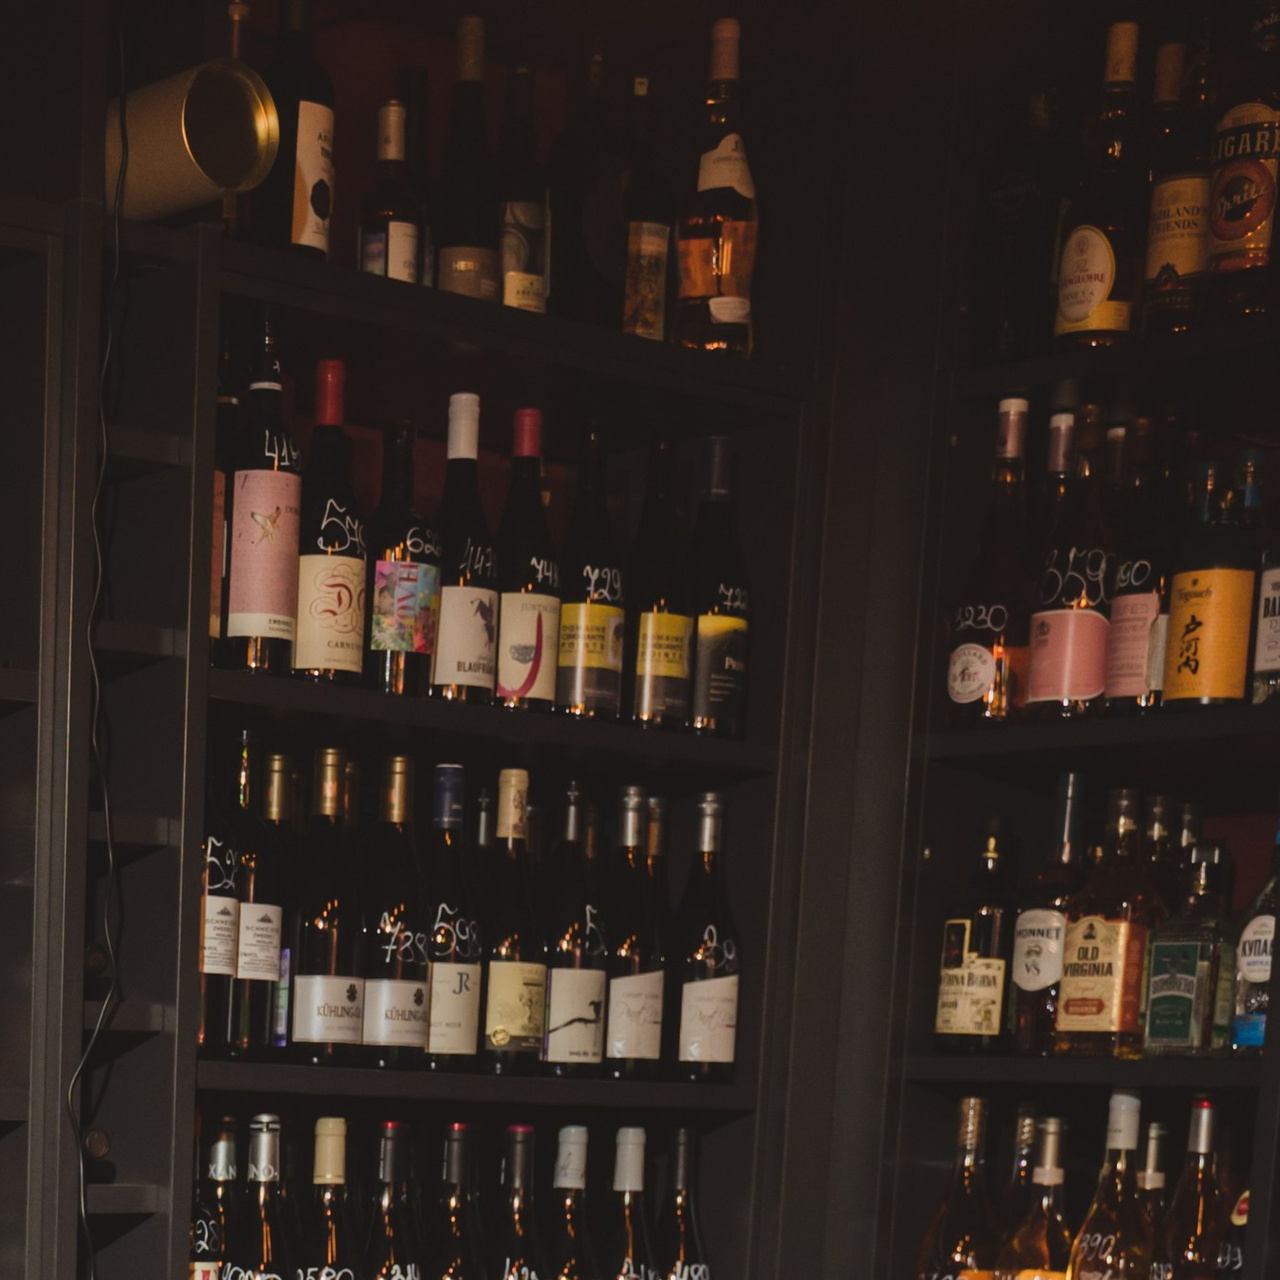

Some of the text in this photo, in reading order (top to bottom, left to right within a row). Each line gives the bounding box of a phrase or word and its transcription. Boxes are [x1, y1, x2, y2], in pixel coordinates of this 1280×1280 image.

[1077, 946, 1099, 961] OLD
[1024, 963, 1040, 977] VS
[1064, 962, 1113, 977] VIRGINIA
